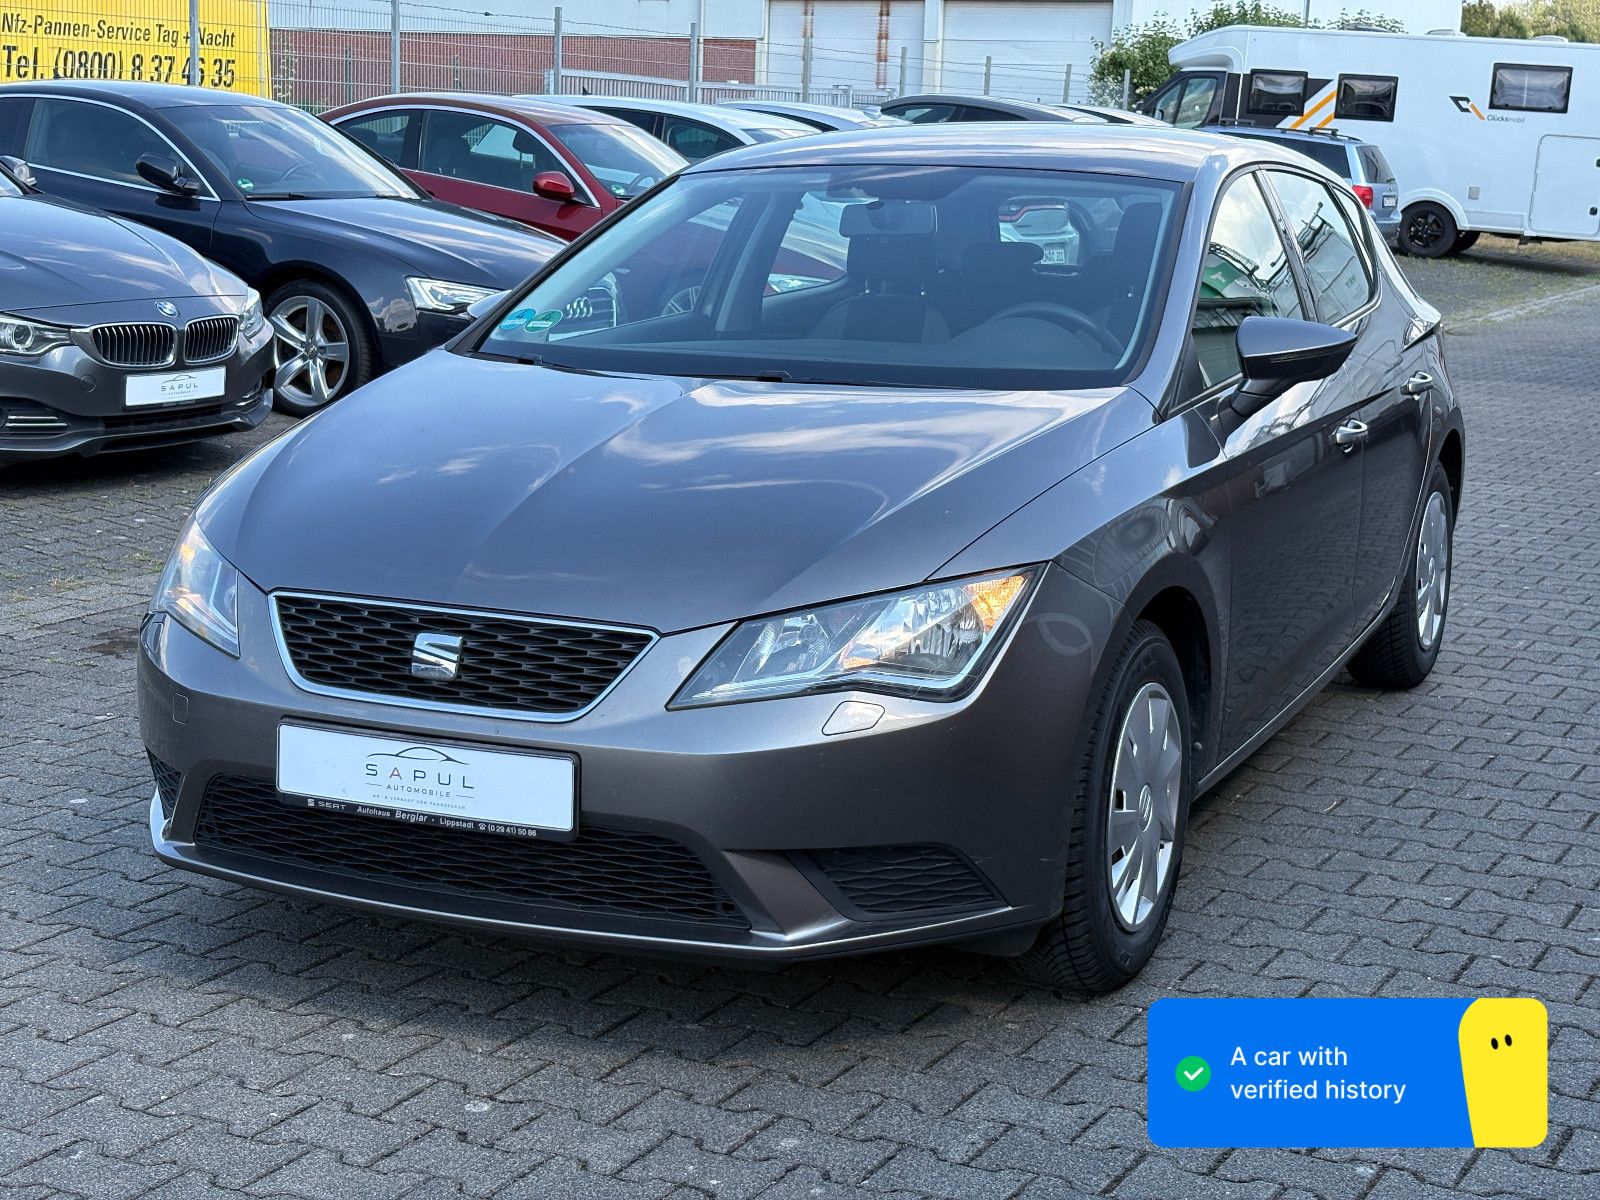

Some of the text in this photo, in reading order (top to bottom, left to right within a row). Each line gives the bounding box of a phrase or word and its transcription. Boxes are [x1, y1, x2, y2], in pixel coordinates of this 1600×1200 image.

[1, 12, 151, 42] Nfz-Pannen-Service
[155, 23, 179, 47] Tag
[198, 27, 236, 48] Nacht
[2, 45, 44, 80] Tel.
[53, 47, 124, 80] (0800)
[131, 53, 144, 81] 8
[150, 54, 176, 83] 37
[211, 58, 236, 88] 35
[160, 381, 199, 392] SAPUL
[365, 763, 475, 789] SAPUL
[386, 784, 451, 798] AUTOMOBILE
[318, 800, 347, 810] SEAT
[356, 805, 391, 817] Autohaus
[395, 810, 428, 823] Berglar
[440, 817, 474, 829] Lippstadt
[496, 825, 505, 833] 29
[506, 826, 517, 835] 41)
[518, 828, 527, 836] 50
